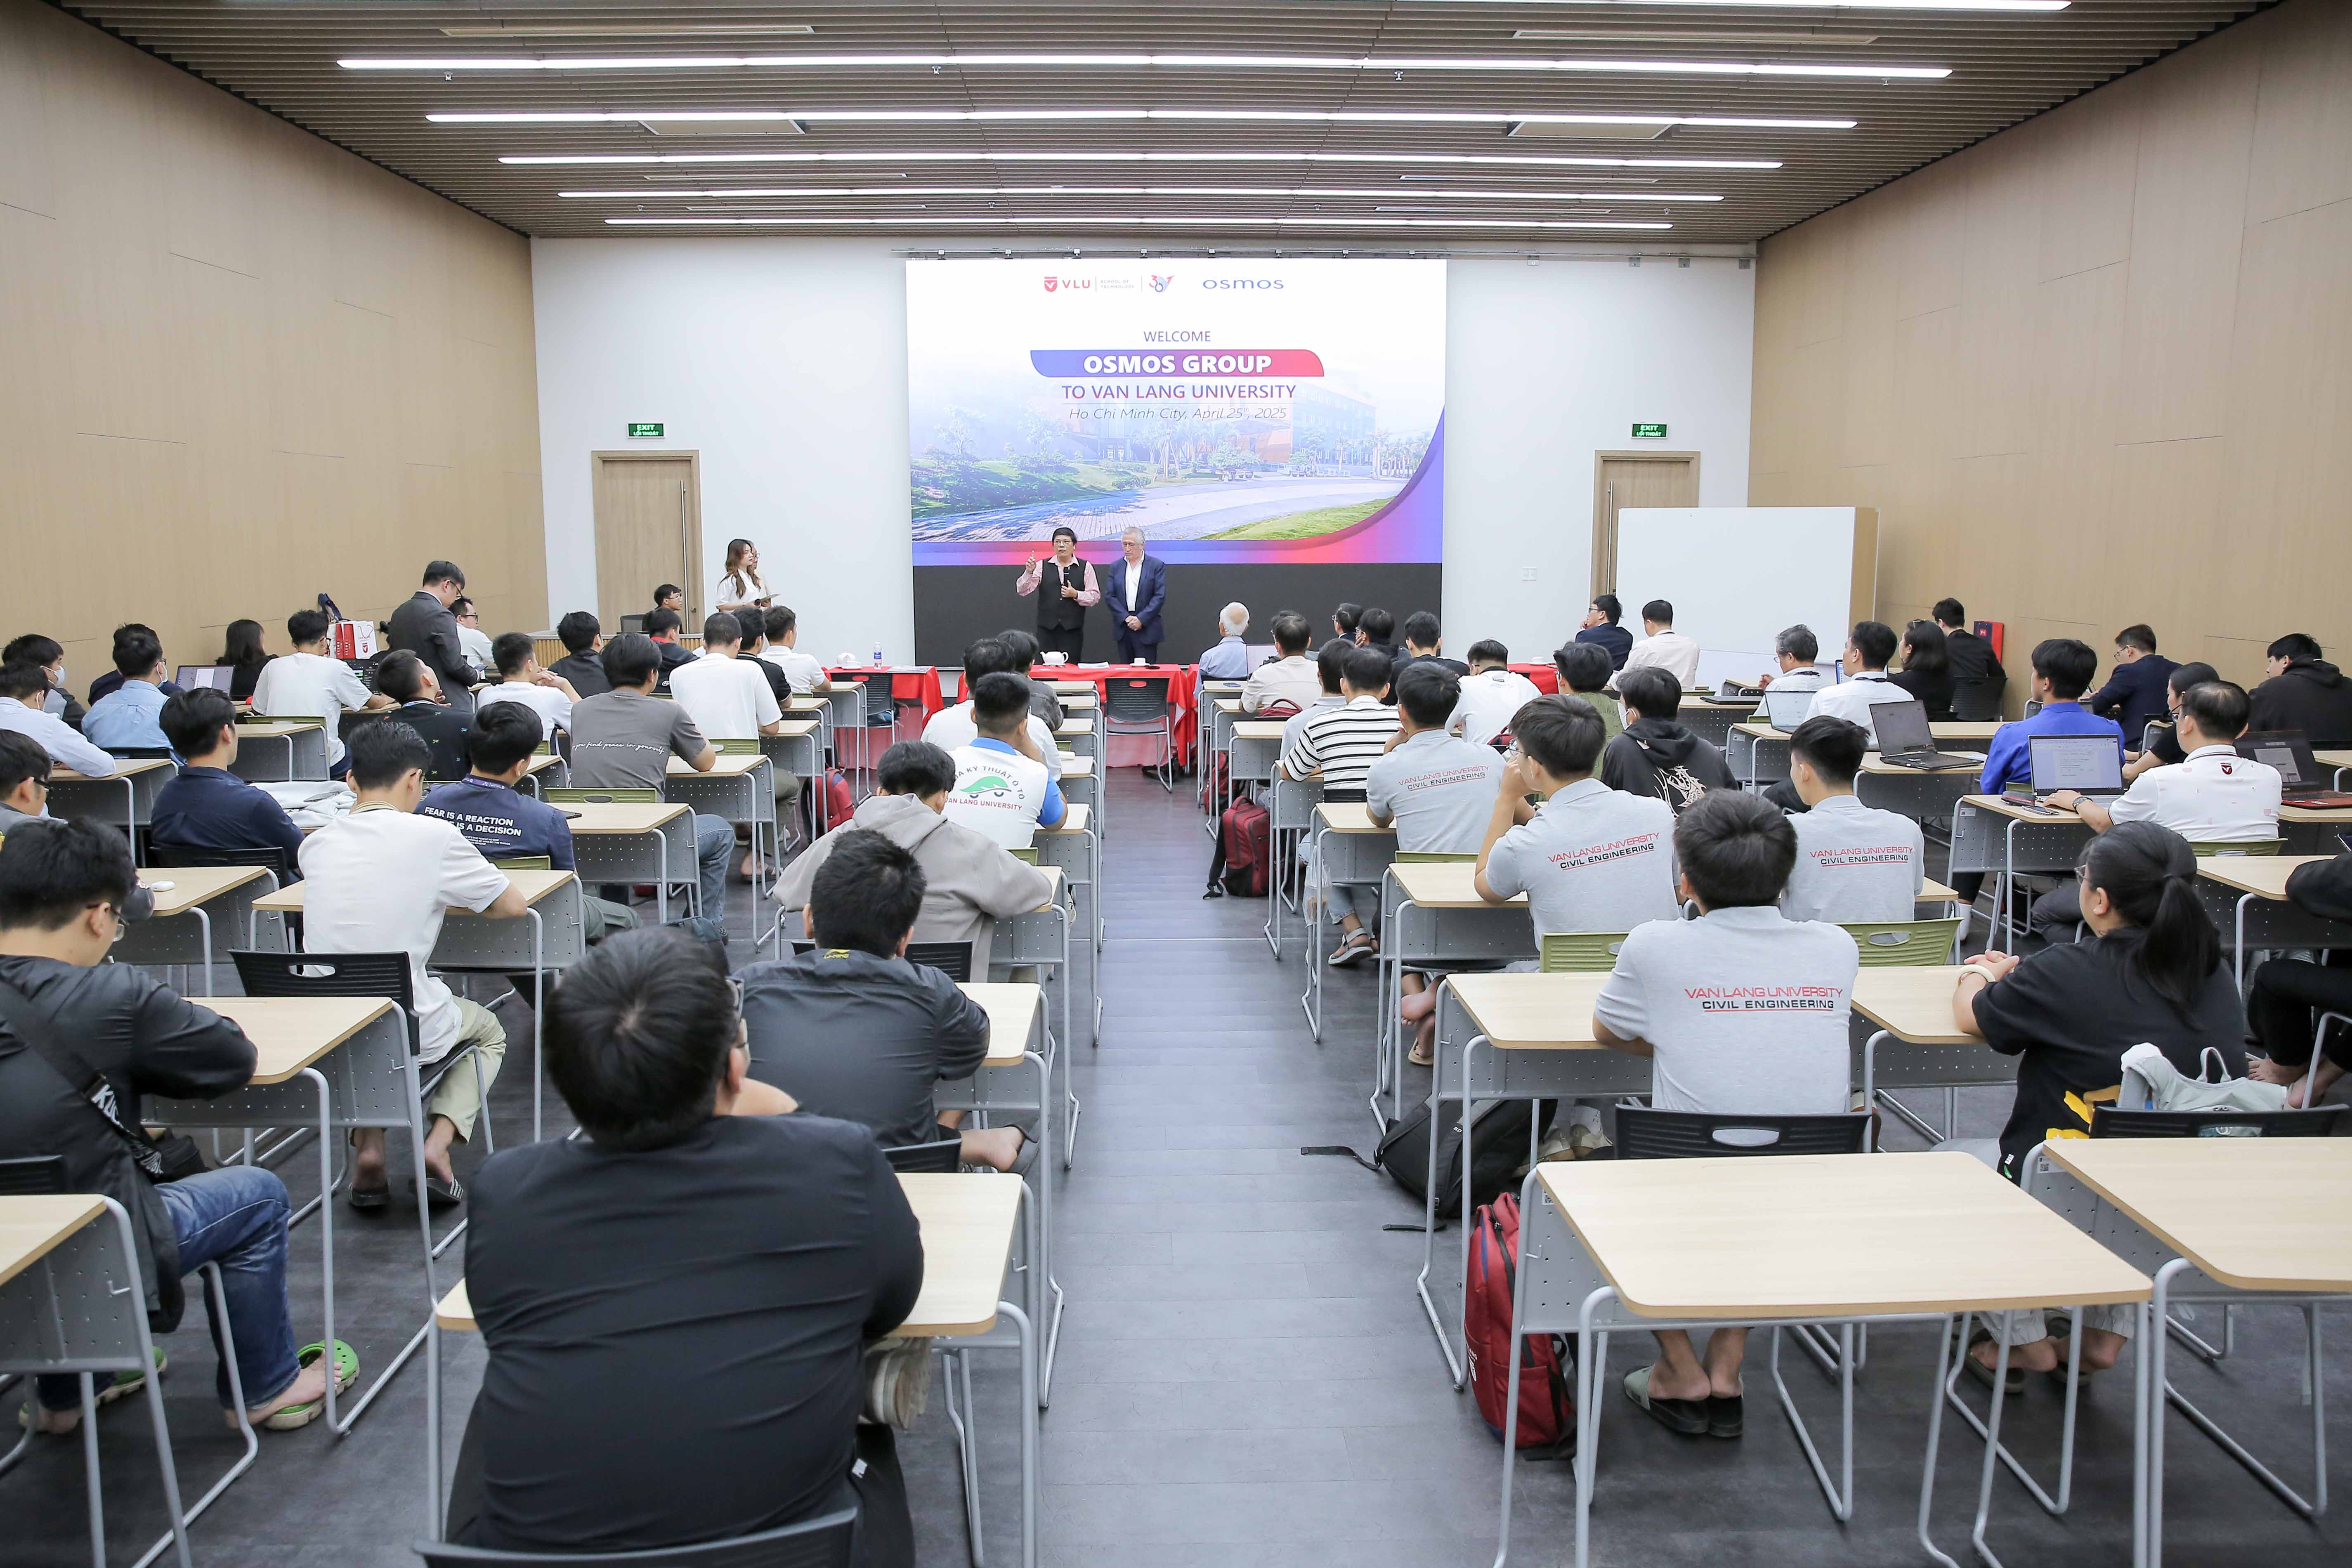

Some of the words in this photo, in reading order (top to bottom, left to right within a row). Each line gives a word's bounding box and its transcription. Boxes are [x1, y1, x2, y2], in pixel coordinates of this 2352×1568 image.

[1062, 279, 1090, 289] VLU
[1203, 279, 1284, 289] osmos
[1143, 331, 1211, 342] WELCOME
[1083, 355, 1176, 373] OSMOS
[1182, 355, 1272, 373] GROUP
[1062, 385, 1085, 399] TO
[1091, 385, 1129, 399] VAN
[1136, 385, 1185, 399] LANG
[1192, 385, 1296, 399] UNIVERSITY
[1069, 409, 1089, 419] Ho
[1093, 408, 1116, 419] Chi
[1120, 408, 1154, 419] Minh
[1159, 408, 1188, 421] City,
[1192, 408, 1223, 421] April
[1254, 408, 1287, 419] 2025
[635, 744, 665, 755] yourself
[1398, 777, 1417, 786] VAN
[1417, 772, 1441, 781] LANG
[1442, 766, 1489, 777] UNIVERSITY
[1407, 781, 1427, 790] CIVIL
[1430, 772, 1485, 785] ENGINEERING
[980, 801, 1022, 811] UNIVERSITY
[425, 807, 445, 817] FEAR
[446, 811, 455, 819] IS
[465, 815, 514, 827] REACTION
[475, 825, 522, 836] DECISION
[1548, 852, 1571, 862] VAN
[1572, 845, 1601, 857] LANG
[1602, 832, 1660, 851] UNIVERSITY
[1560, 859, 1585, 869] CIVIL
[1588, 843, 1654, 863] ENGINEERING
[1849, 855, 1908, 863] ENGINEERING
[1684, 987, 1721, 999] VAN
[1723, 987, 1765, 997] LANG
[1767, 987, 1843, 998] UNIVERSITY
[1702, 1001, 1739, 1009] CIVIL
[1745, 1000, 1834, 1009] ENGINEERING
